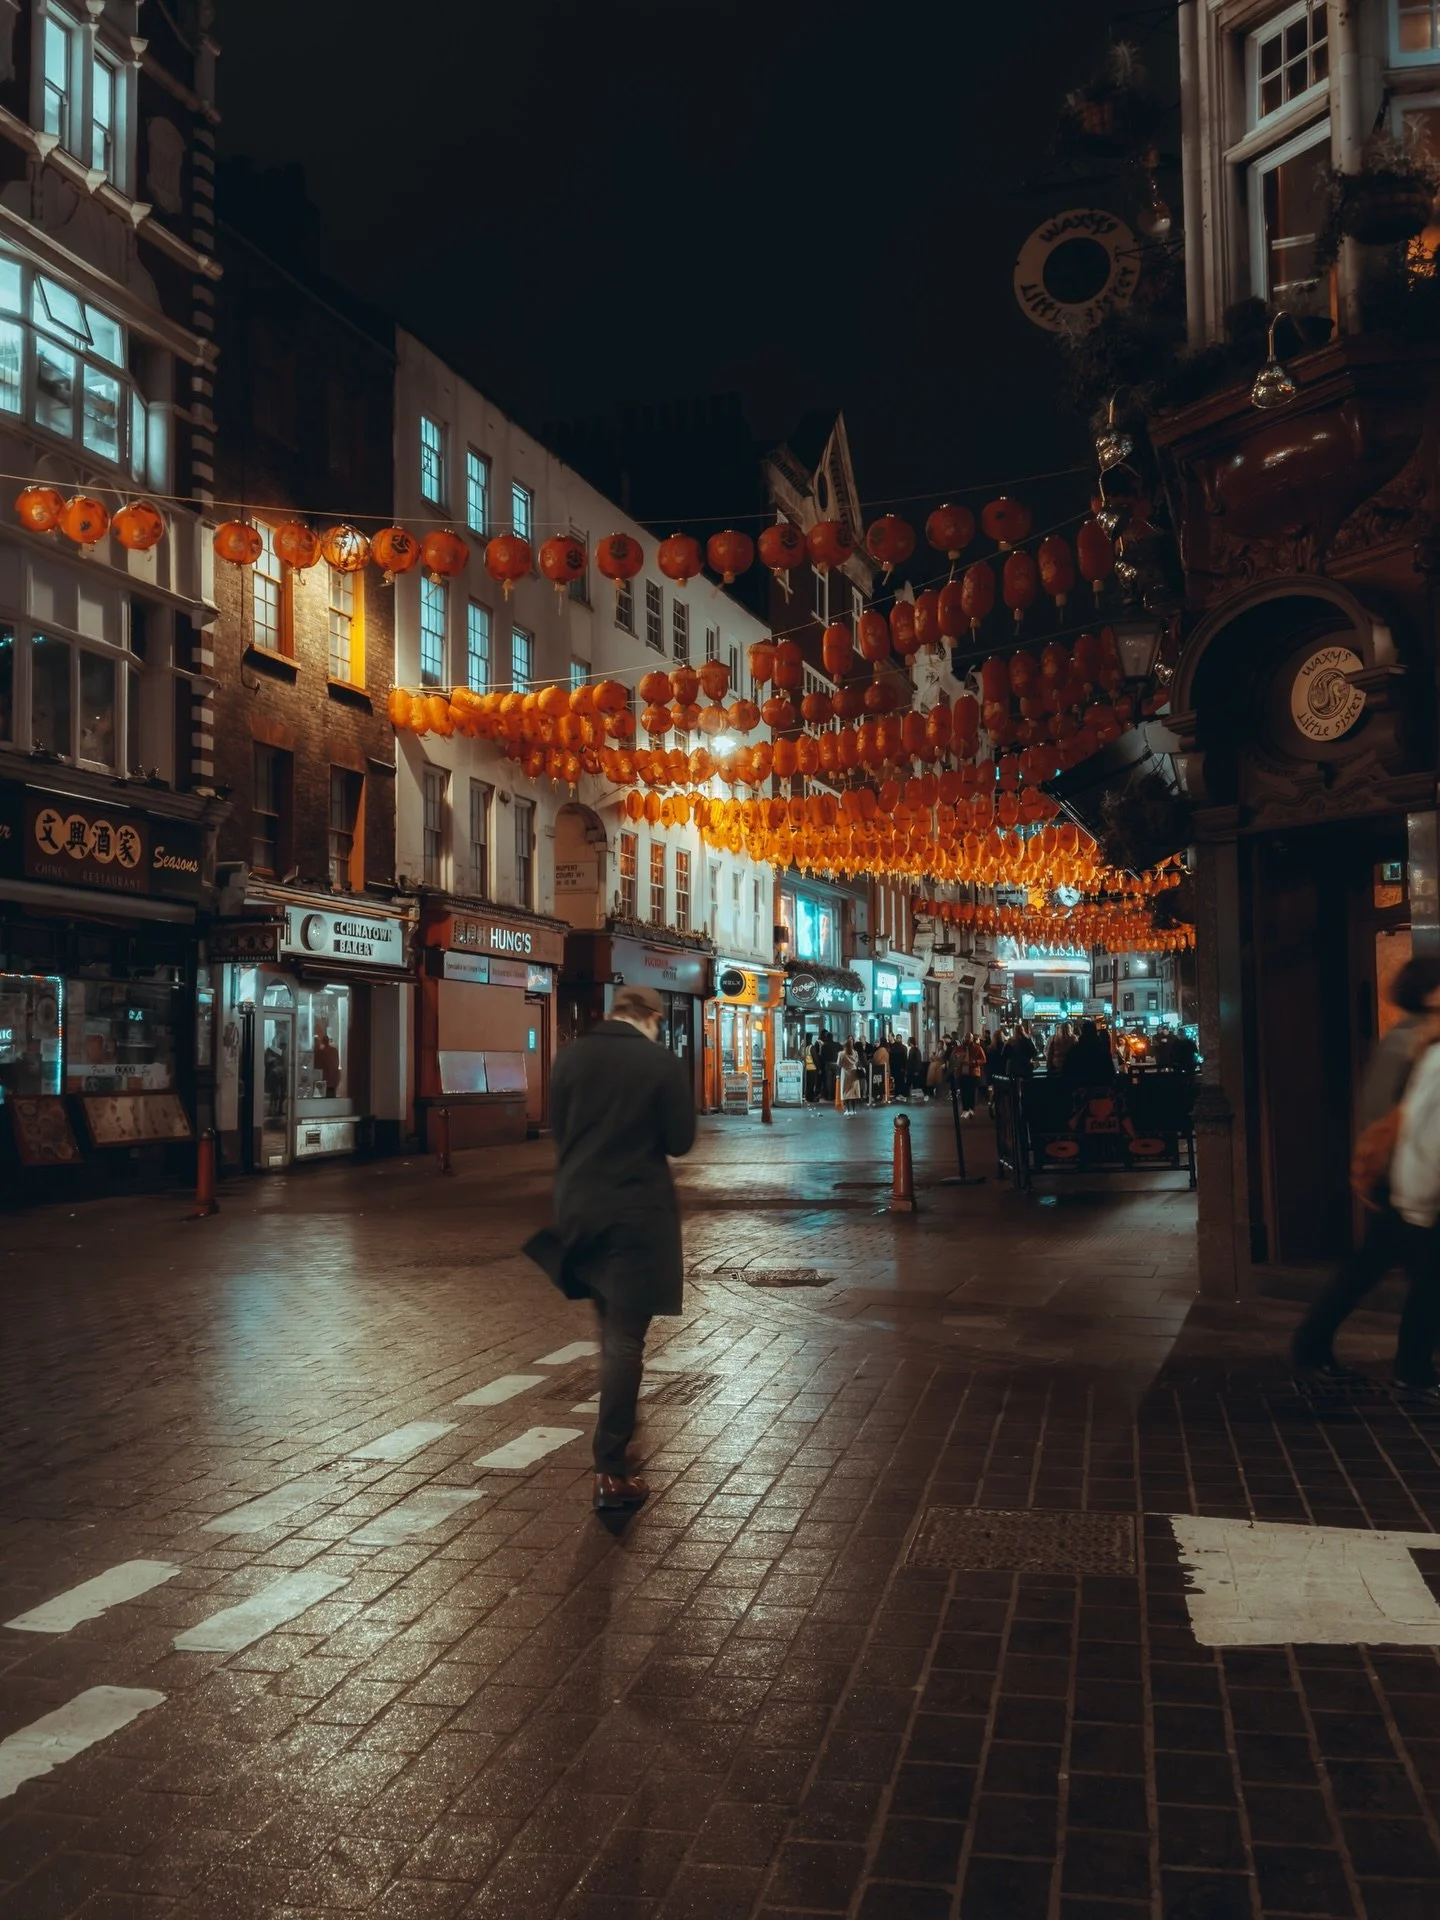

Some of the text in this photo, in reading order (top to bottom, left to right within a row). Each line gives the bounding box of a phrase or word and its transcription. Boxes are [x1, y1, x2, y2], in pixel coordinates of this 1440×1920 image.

[38, 812, 138, 864] 文興酒家
[152, 846, 200, 873] Seasons
[82, 870, 141, 889] RESTAURANT
[335, 921, 393, 942] CHINATOWN
[490, 927, 532, 954] HUNG'S
[335, 940, 374, 956] BAKERY
